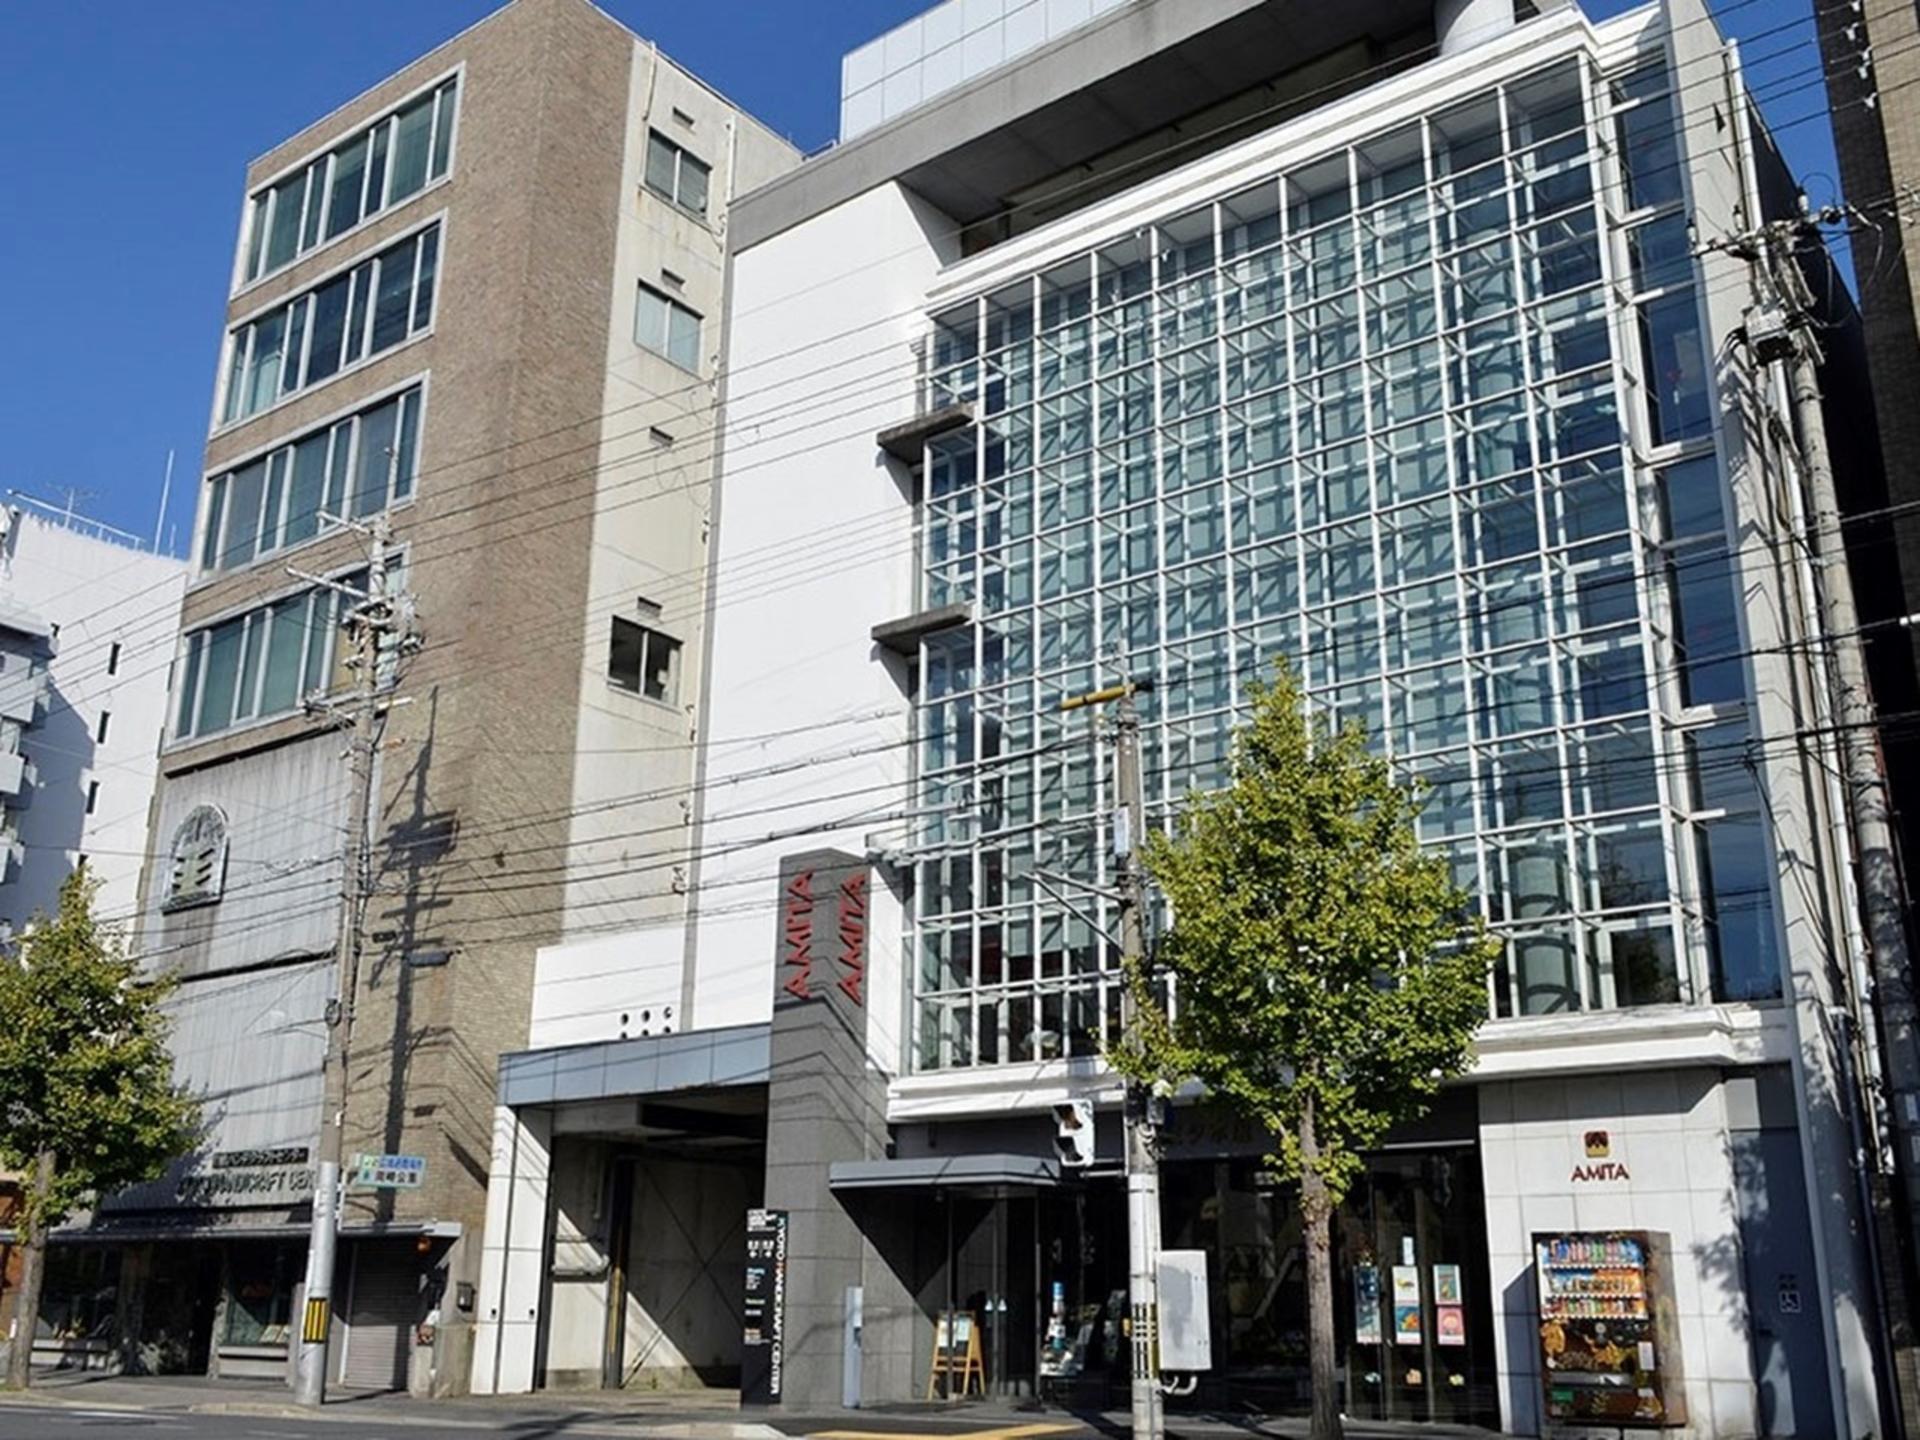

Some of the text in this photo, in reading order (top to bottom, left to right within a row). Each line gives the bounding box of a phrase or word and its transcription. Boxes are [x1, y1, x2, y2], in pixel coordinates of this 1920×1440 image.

[784, 869, 814, 1000] AMITA
[837, 873, 866, 1007] AMITA
[1571, 1163, 1630, 1182] AMITA
[775, 1217, 786, 1262] KYOTO
[770, 1343, 783, 1396] CENTER
